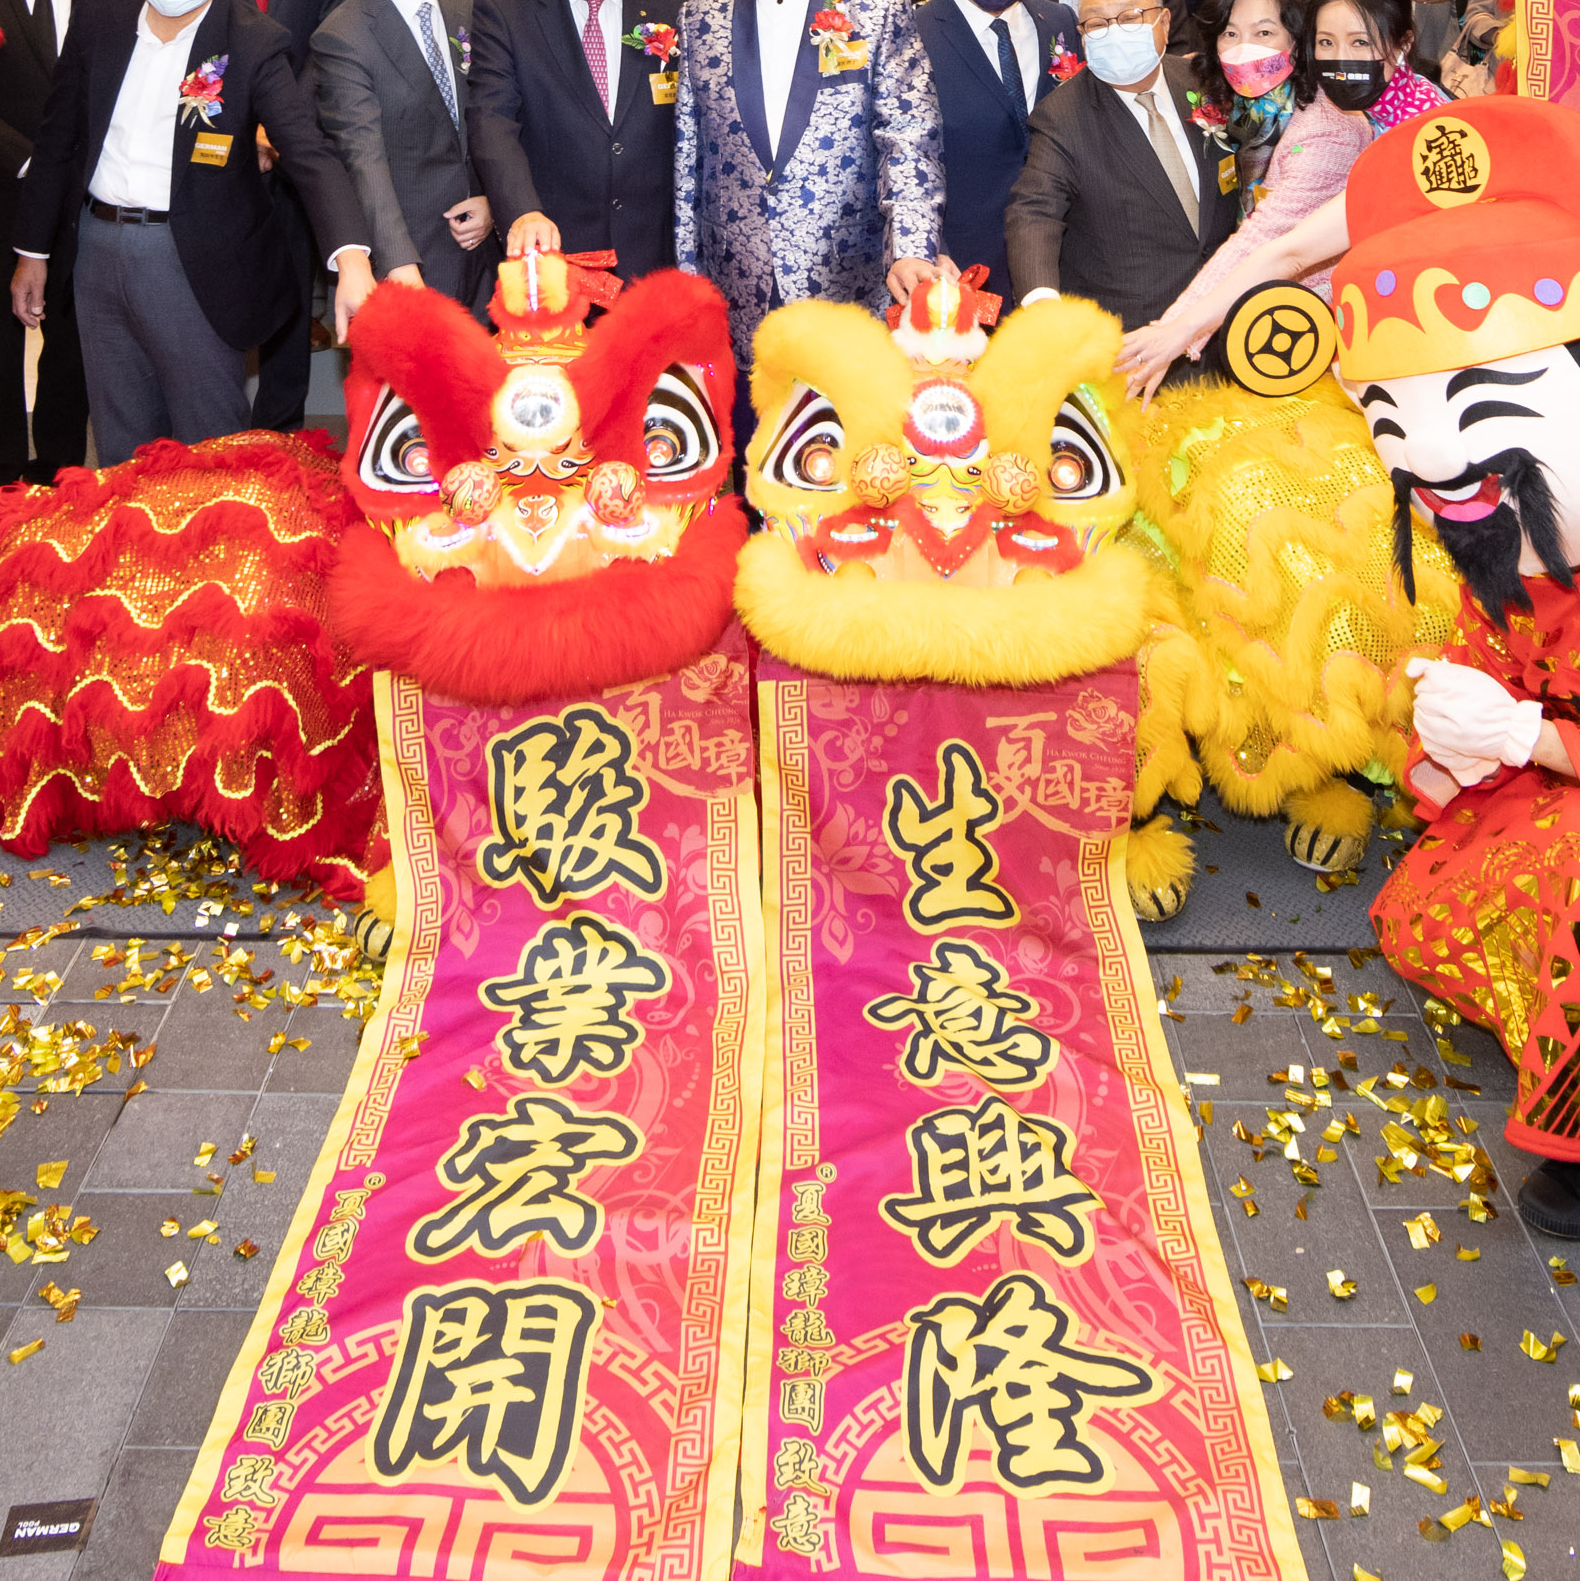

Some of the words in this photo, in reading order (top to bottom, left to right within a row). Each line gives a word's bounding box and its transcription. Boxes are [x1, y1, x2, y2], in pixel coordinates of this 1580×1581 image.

[362, 707, 671, 1515] 駿業宏開
[862, 737, 1167, 1499] 生意興隆
[13, 1521, 81, 1539] GERMAN
[202, 1186, 370, 1552] 夏國璋龍獅團致意
[772, 1180, 837, 1553] 夏國璋龍獅團致意
